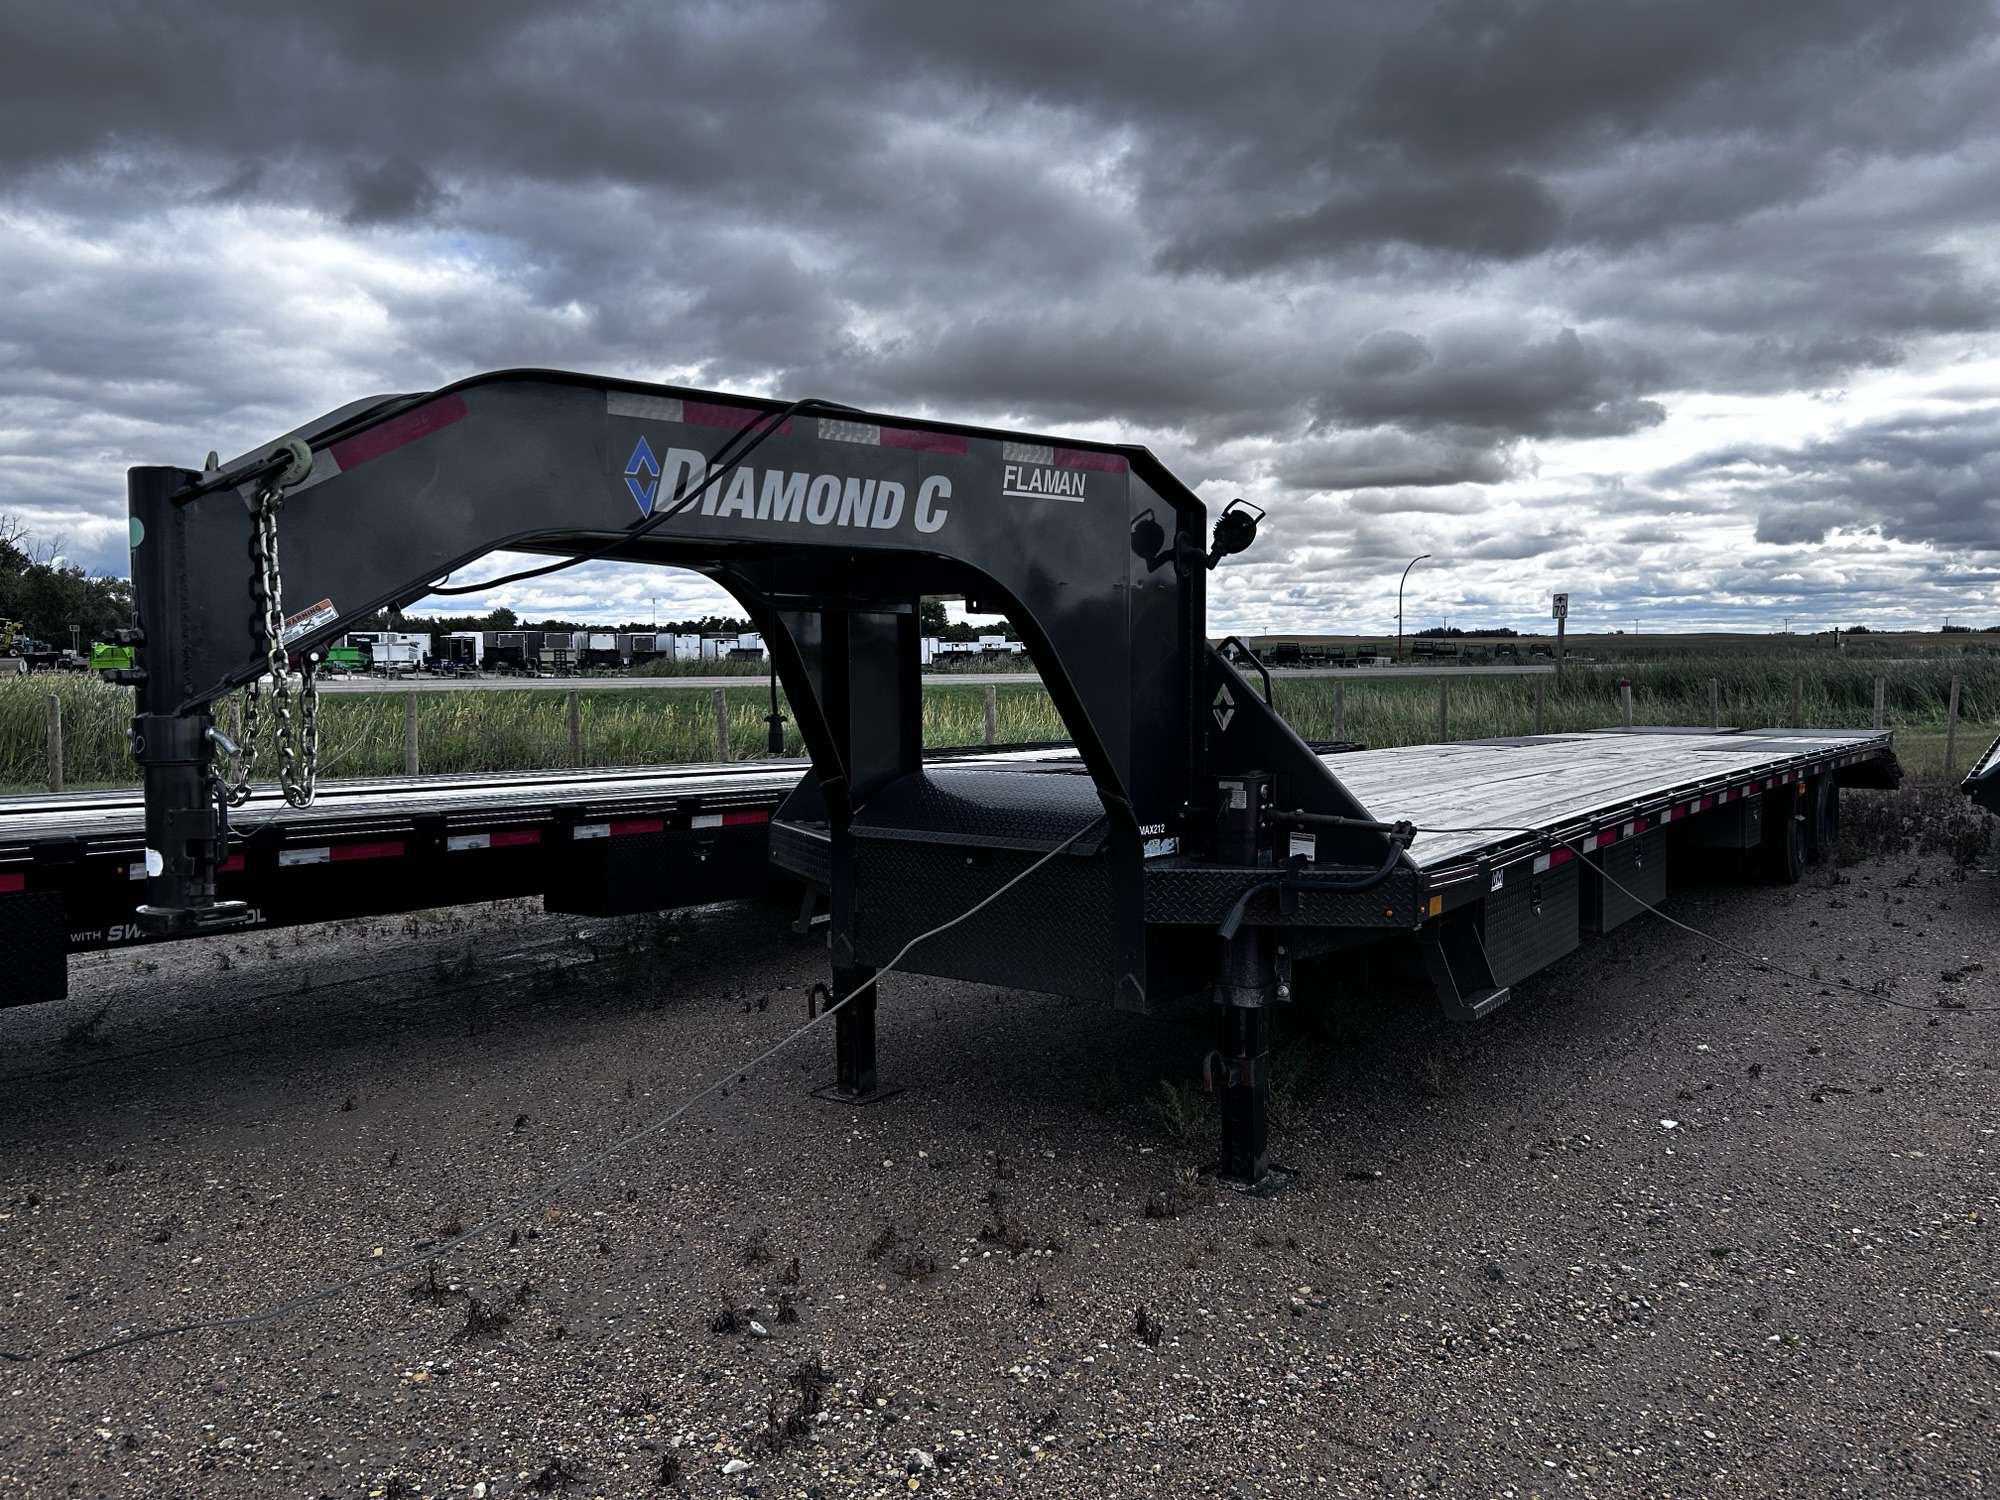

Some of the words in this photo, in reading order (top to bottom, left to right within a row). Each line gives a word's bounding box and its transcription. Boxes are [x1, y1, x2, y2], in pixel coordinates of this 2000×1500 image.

[654, 447, 905, 529] DIAMOND
[914, 475, 952, 533] C
[1003, 464, 1086, 496] FLAMAN
[1554, 604, 1566, 617] 70
[70, 930, 101, 942] WITH
